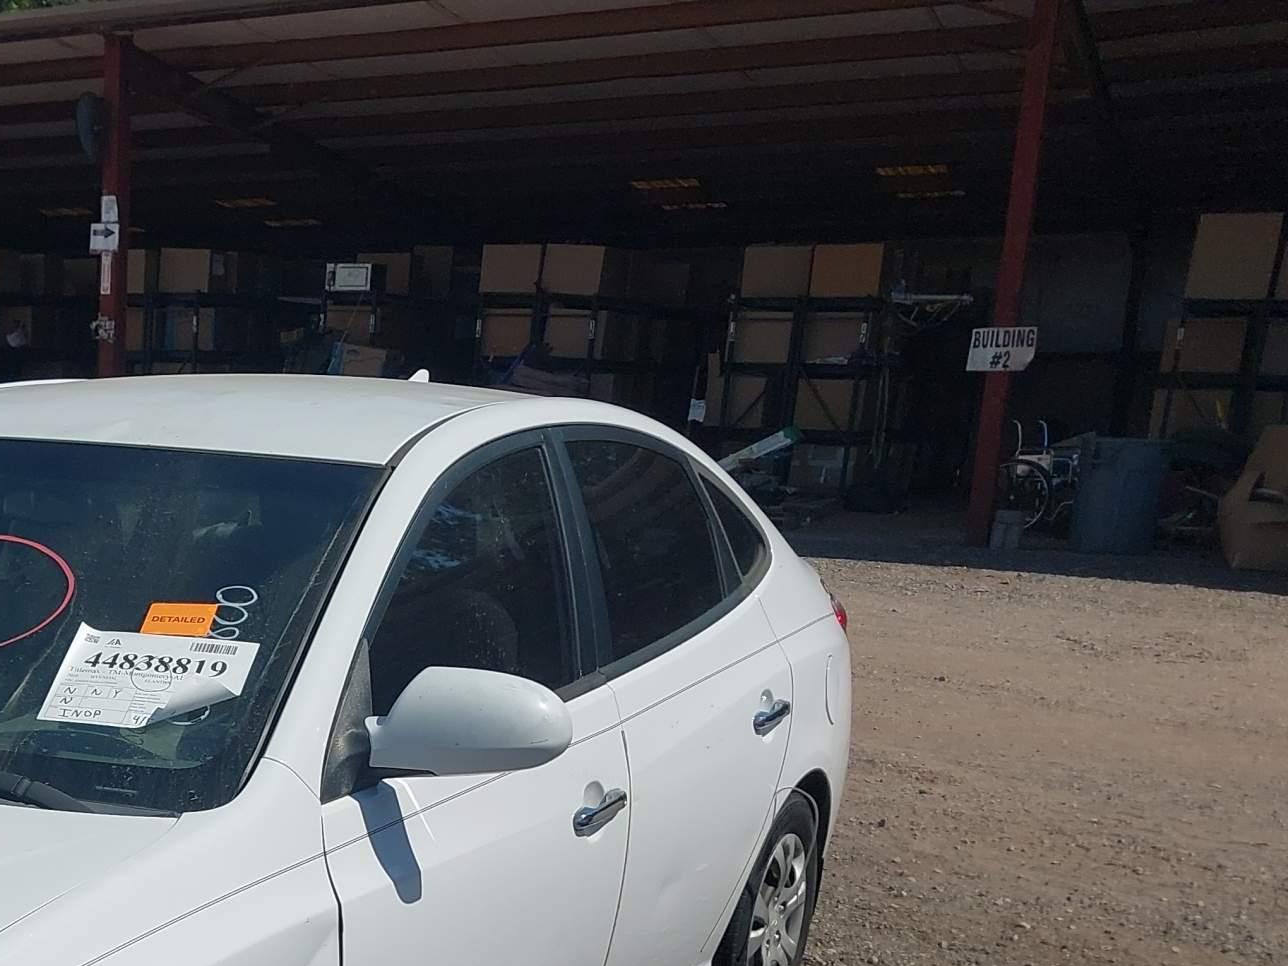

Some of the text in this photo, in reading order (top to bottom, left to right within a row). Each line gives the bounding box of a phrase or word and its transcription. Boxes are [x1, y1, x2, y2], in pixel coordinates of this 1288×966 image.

[972, 328, 1035, 349] BUILDING
[989, 350, 1011, 369] #2
[151, 614, 206, 624] DETAILED
[83, 651, 228, 678] 44838819
[64, 687, 77, 695] N
[59, 697, 73, 705] N
[58, 708, 102, 718] INOP
